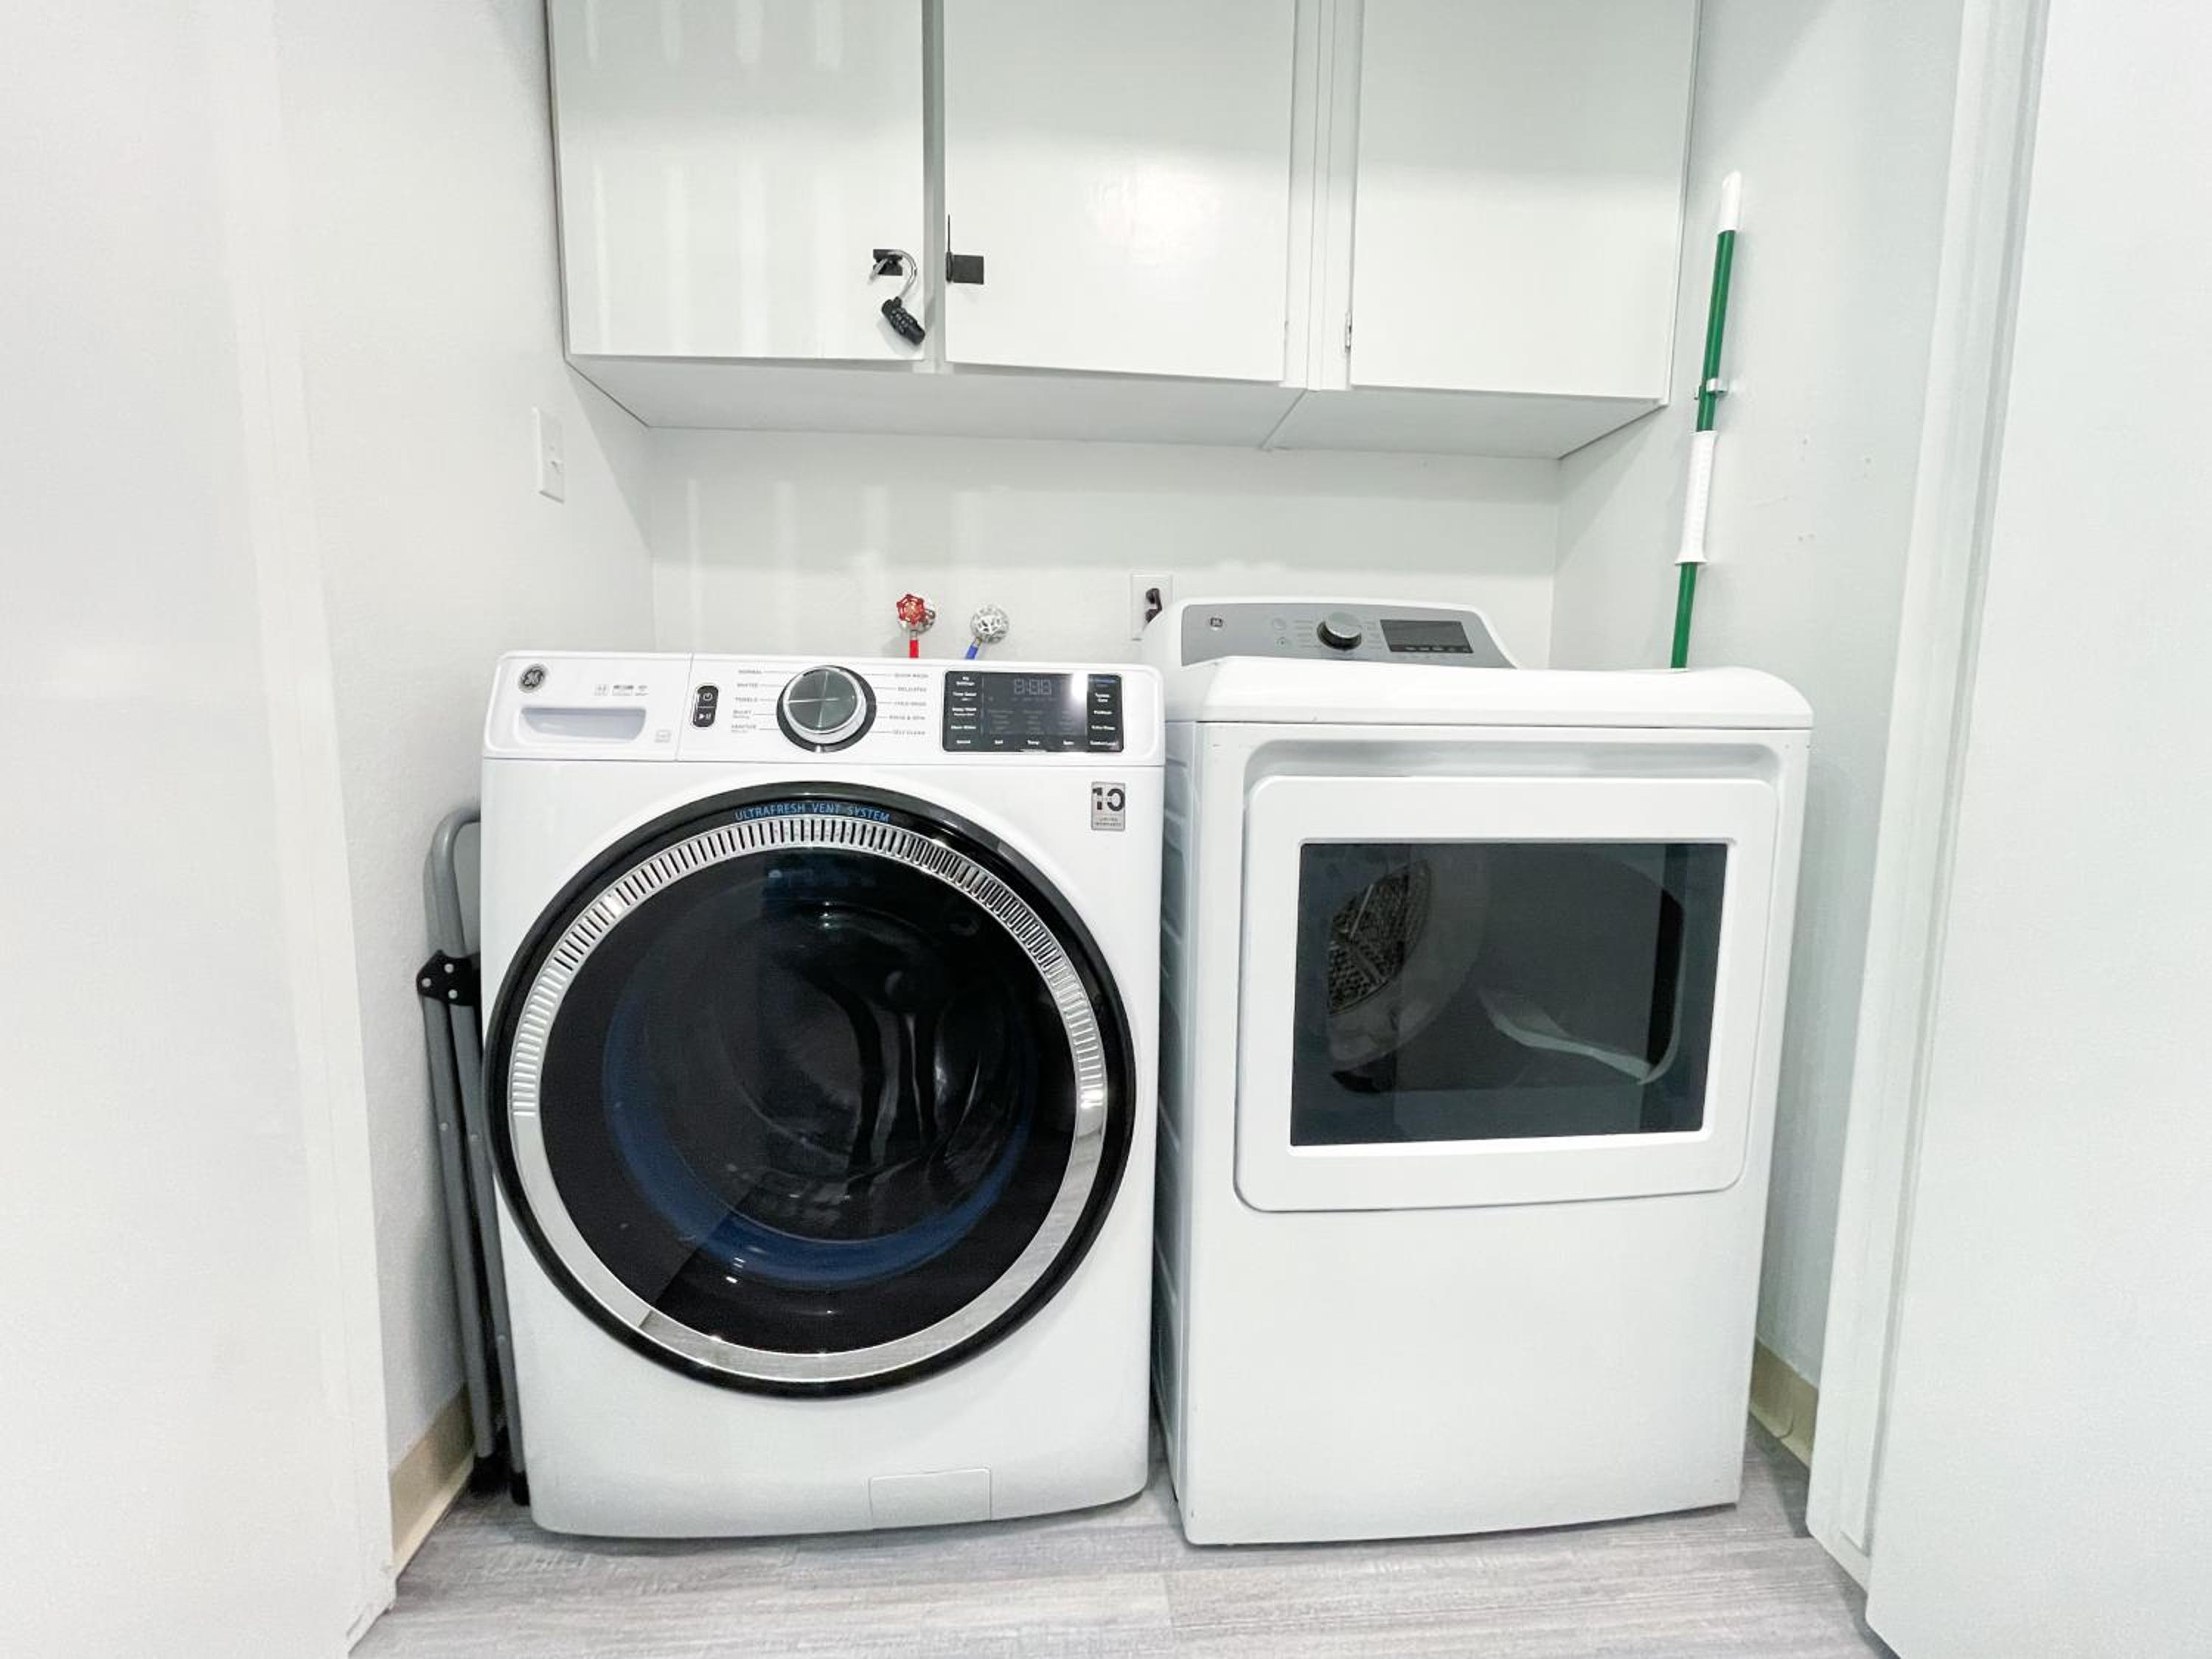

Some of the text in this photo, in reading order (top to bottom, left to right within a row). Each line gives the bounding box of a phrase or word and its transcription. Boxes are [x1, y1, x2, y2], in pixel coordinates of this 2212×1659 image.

[1092, 787, 1126, 812] 10
[734, 802, 891, 823] ULTRAFRESH VENT SYSTEM
